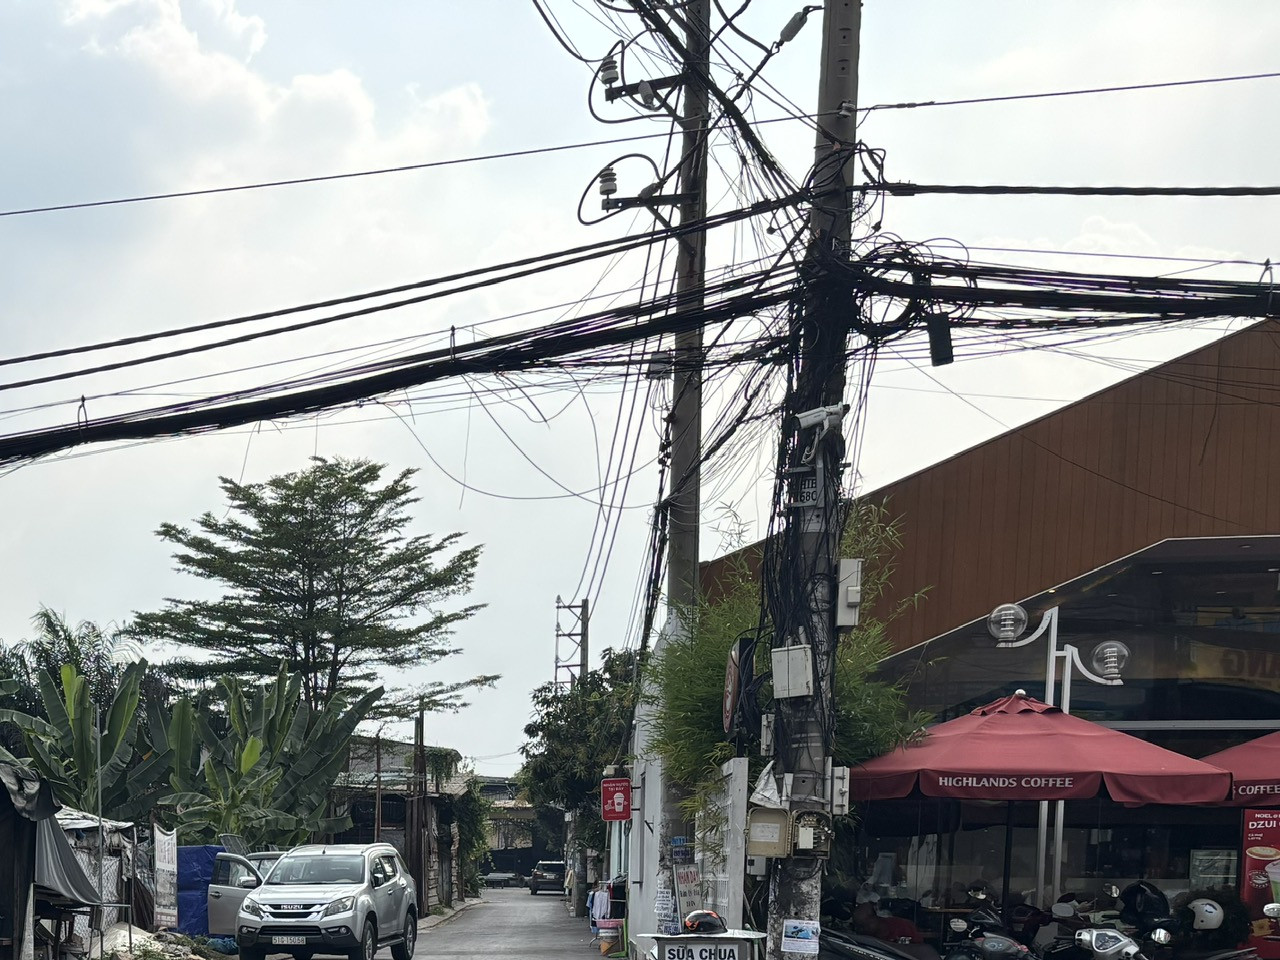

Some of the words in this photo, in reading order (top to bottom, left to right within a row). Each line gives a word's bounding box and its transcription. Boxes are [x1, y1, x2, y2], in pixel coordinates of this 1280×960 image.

[939, 777, 1017, 787] HIGHLANDS
[1021, 777, 1073, 788] COFFEE
[1238, 785, 1280, 794] COFFEE
[1248, 820, 1276, 829] DZUI
[667, 945, 695, 960] SỮA
[699, 948, 736, 960] CHUA
